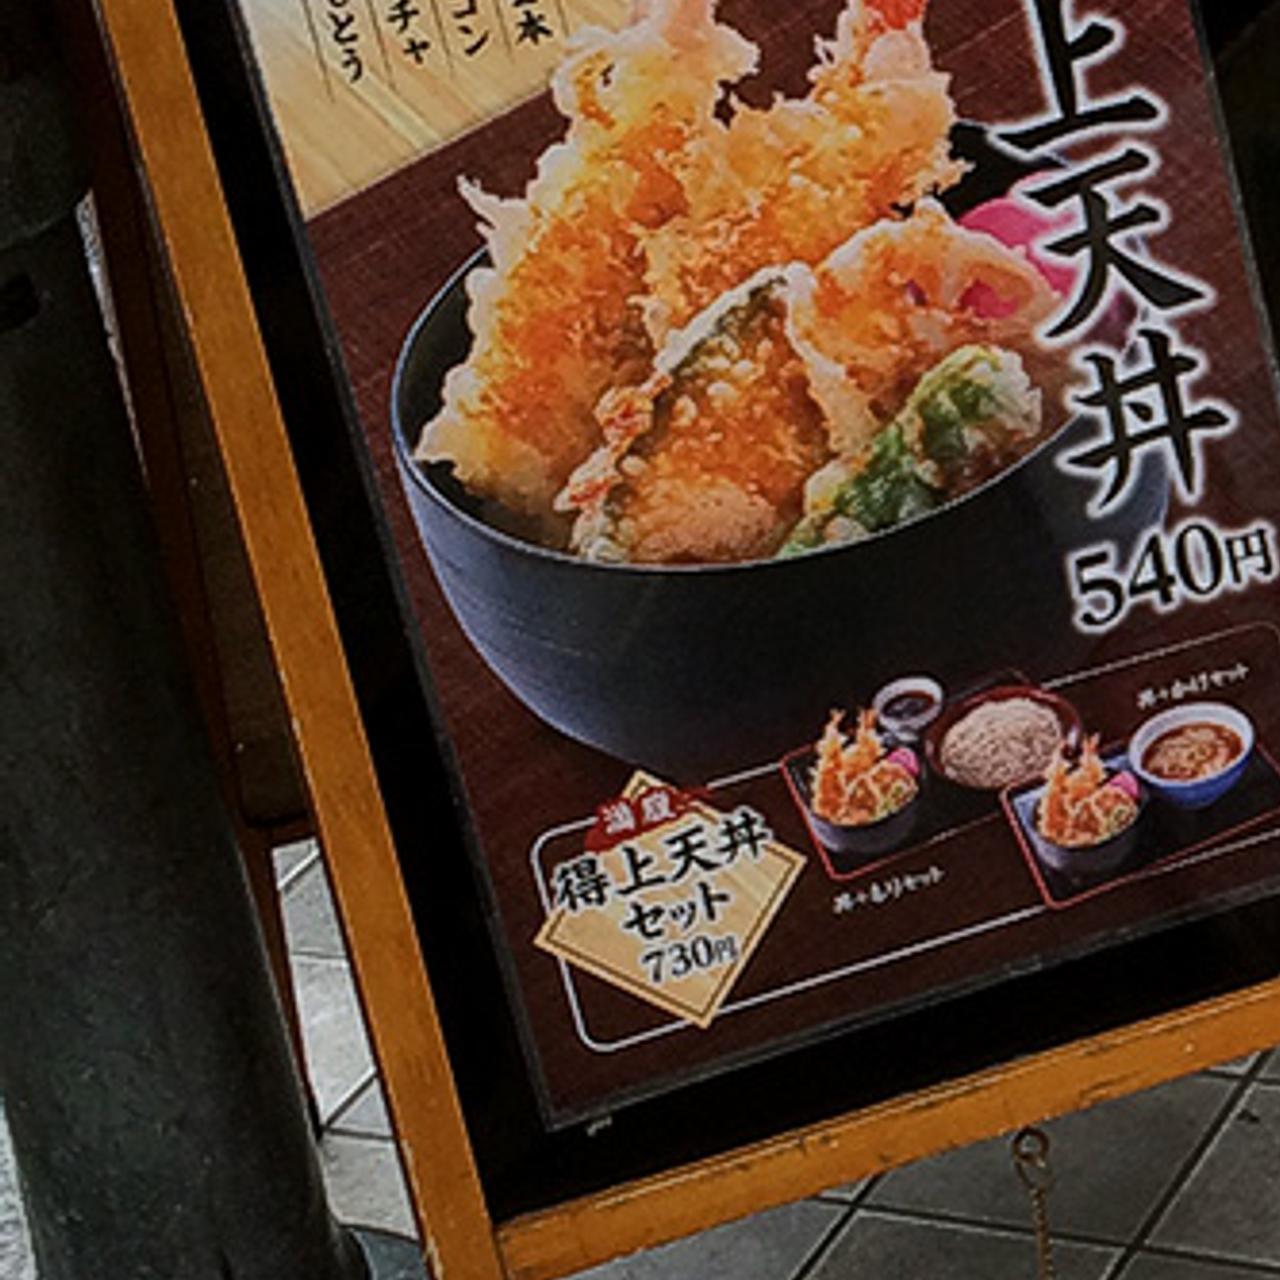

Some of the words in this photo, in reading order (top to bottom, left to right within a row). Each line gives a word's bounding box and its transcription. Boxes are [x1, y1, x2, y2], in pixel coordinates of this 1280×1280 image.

[1073, 523, 1278, 628] 540円
[556, 810, 770, 912] 得上天丼
[622, 881, 730, 939] セット
[641, 935, 739, 983] 730円
